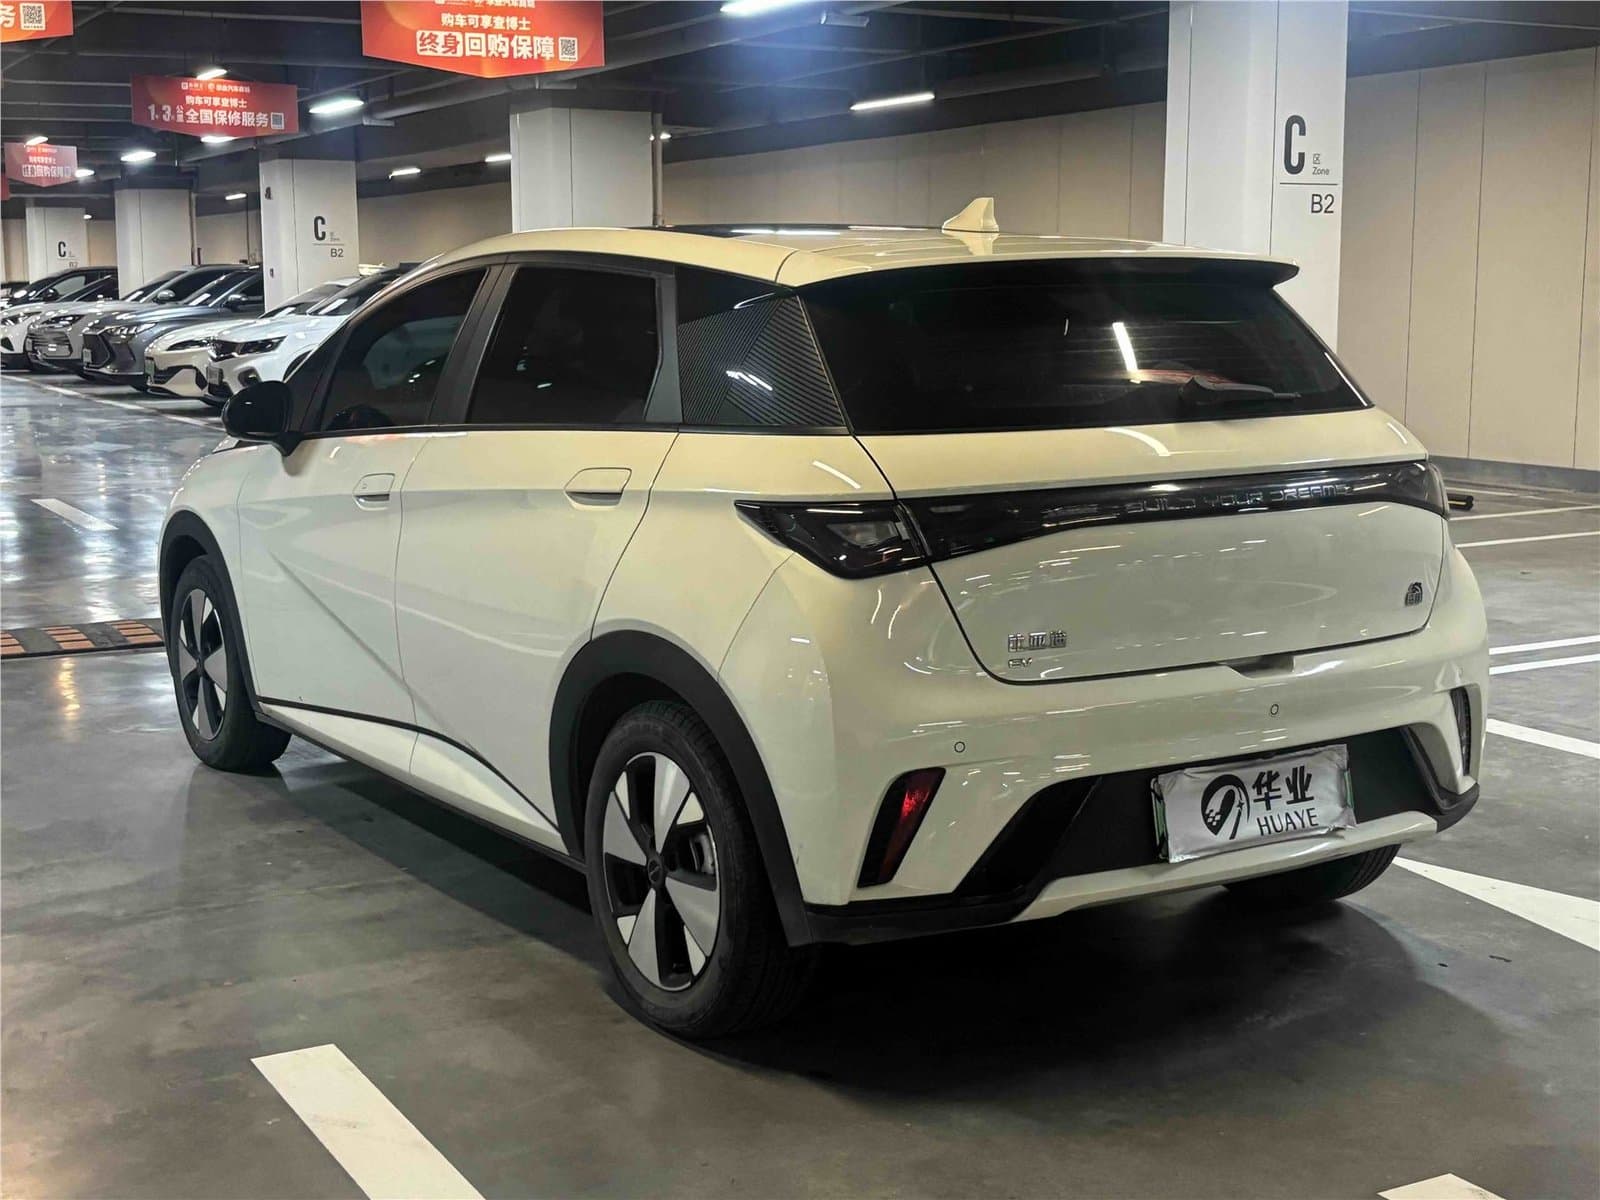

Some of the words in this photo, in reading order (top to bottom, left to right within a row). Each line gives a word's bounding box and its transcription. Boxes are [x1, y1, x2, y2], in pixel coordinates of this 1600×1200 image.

[441, 12, 531, 31] 购车可享查博士
[418, 31, 555, 60] 终身回购保障
[186, 108, 269, 127] 全国保修服务
[1283, 115, 1306, 175] C
[1312, 166, 1330, 176] Zone
[1311, 193, 1335, 214] B2
[313, 215, 326, 241] C
[58, 241, 66, 258] C
[330, 248, 344, 258] B2
[1253, 765, 1315, 811] 华业
[1257, 807, 1319, 836] HUAYE
